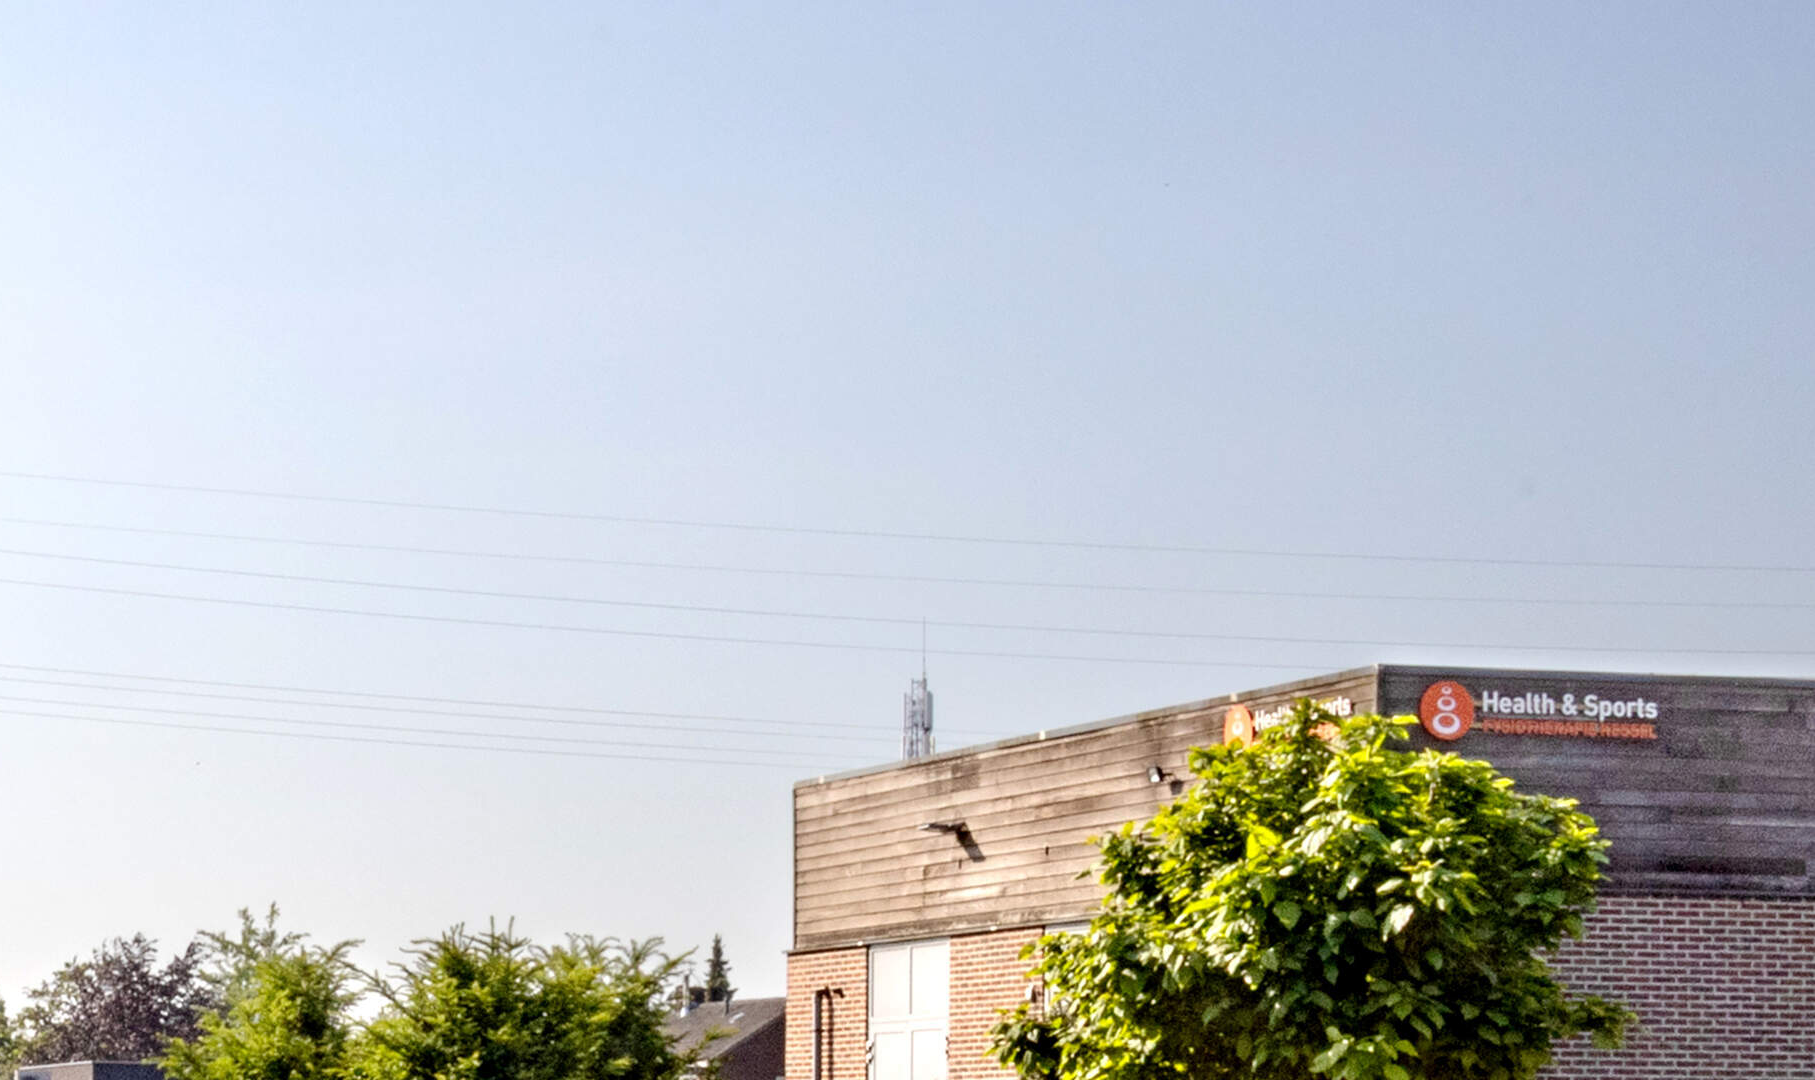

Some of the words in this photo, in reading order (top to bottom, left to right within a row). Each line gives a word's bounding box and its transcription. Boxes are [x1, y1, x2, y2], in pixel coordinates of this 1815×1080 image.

[1482, 690, 1555, 714] Health
[1561, 693, 1578, 715] &
[1583, 694, 1659, 722] Sports
